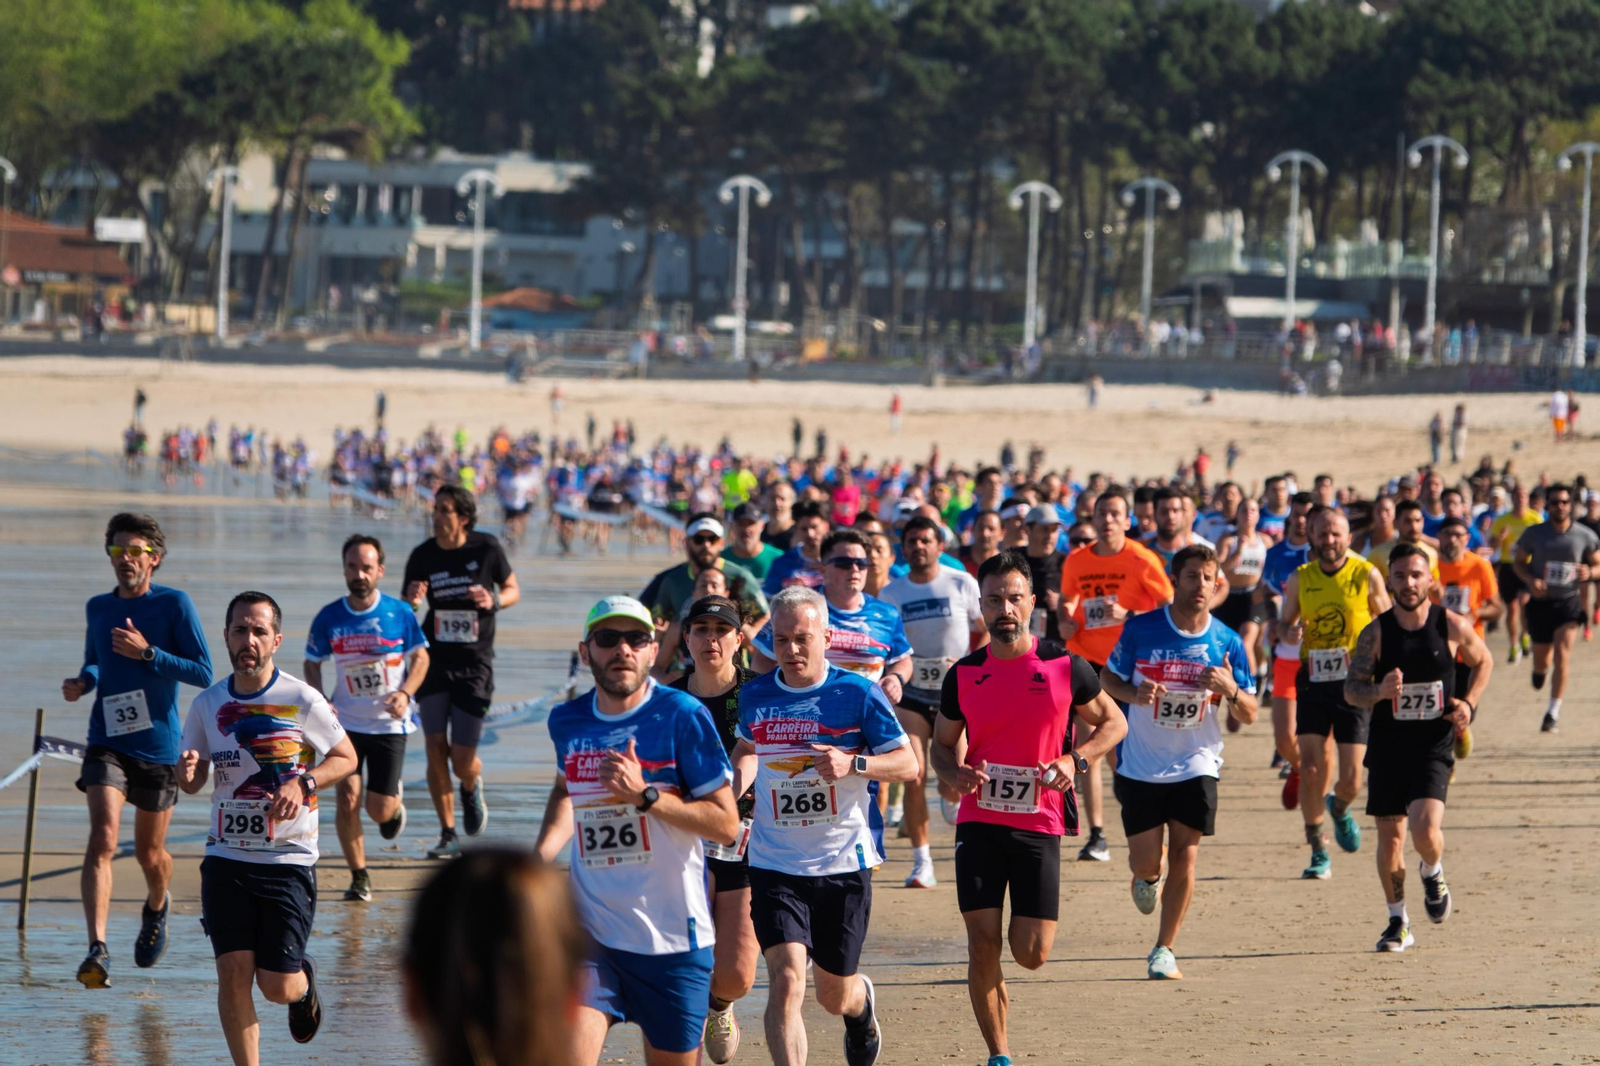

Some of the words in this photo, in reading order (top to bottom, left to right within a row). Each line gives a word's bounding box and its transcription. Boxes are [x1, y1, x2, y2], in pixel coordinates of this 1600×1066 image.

[442, 620, 471, 633] 199
[1163, 663, 1204, 675] CARREIR
[1315, 658, 1342, 673] 147
[353, 674, 383, 690] 132
[919, 668, 941, 681] 39
[1401, 694, 1436, 710] 275
[114, 706, 139, 723] 33
[768, 706, 786, 722] FE
[787, 714, 820, 724] seguros
[1161, 702, 1198, 719] 349
[766, 722, 820, 734] CARREIRA
[766, 733, 787, 741] PRAIA
[788, 733, 798, 741] DE
[797, 733, 819, 741] SAMIL
[988, 778, 1031, 800] 157
[780, 792, 827, 815] 268
[224, 813, 265, 835] 298
[583, 822, 637, 851] 326
